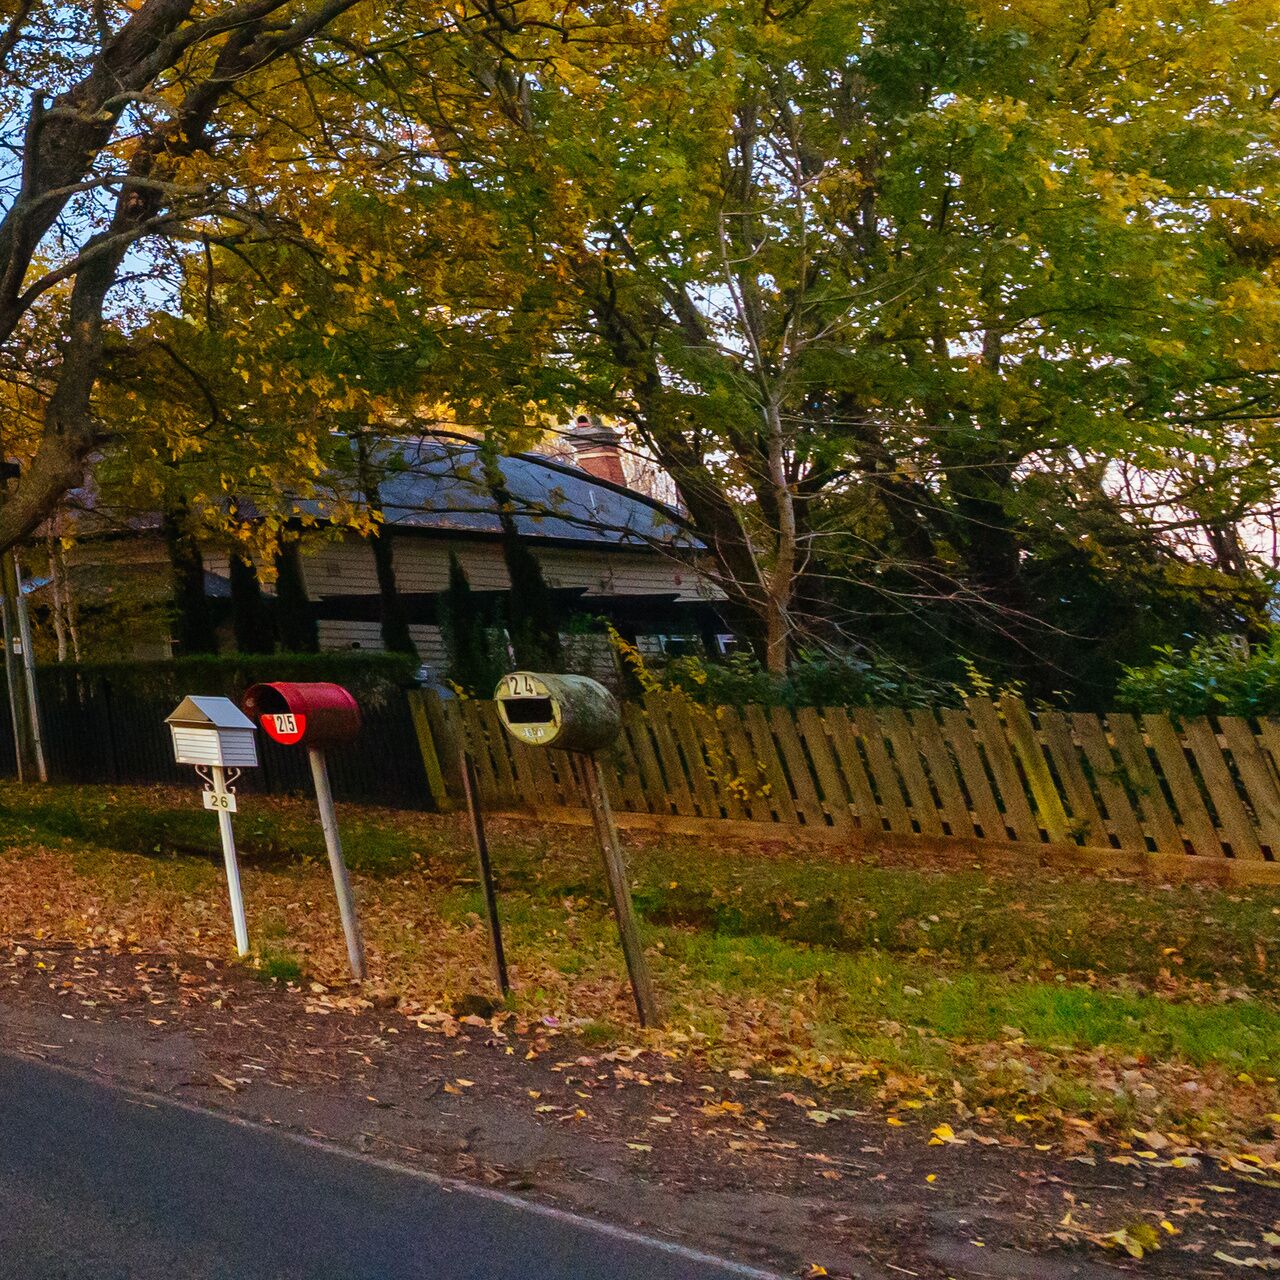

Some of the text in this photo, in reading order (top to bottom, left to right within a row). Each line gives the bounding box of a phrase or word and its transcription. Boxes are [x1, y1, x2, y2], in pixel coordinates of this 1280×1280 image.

[509, 676, 534, 695] 24
[276, 715, 296, 732] 25
[211, 794, 228, 808] 26
